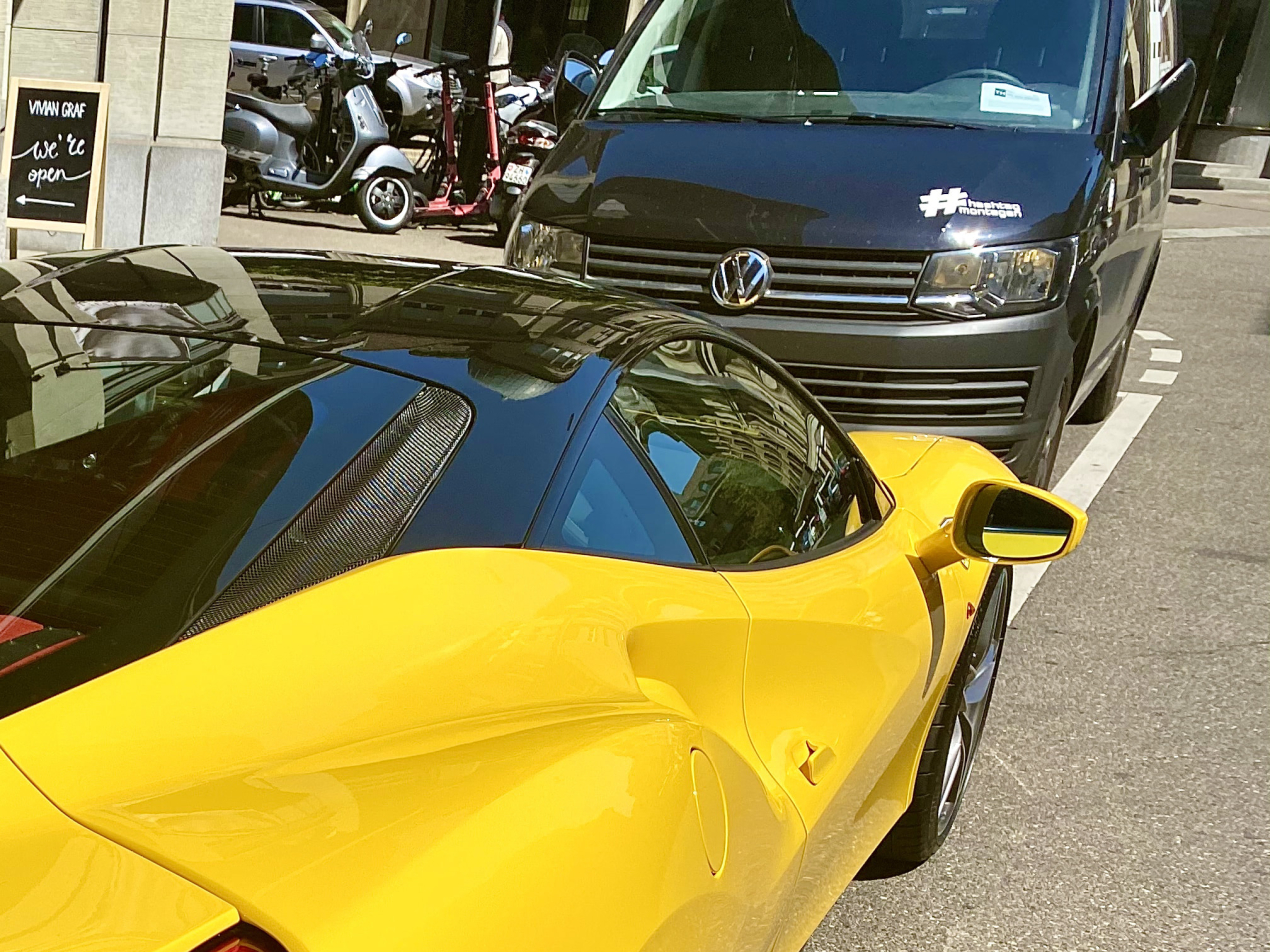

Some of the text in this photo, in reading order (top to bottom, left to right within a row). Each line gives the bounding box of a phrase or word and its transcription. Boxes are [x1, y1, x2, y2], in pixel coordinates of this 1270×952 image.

[28, 99, 87, 118] VIVIAN GRAF
[27, 167, 90, 189] open
